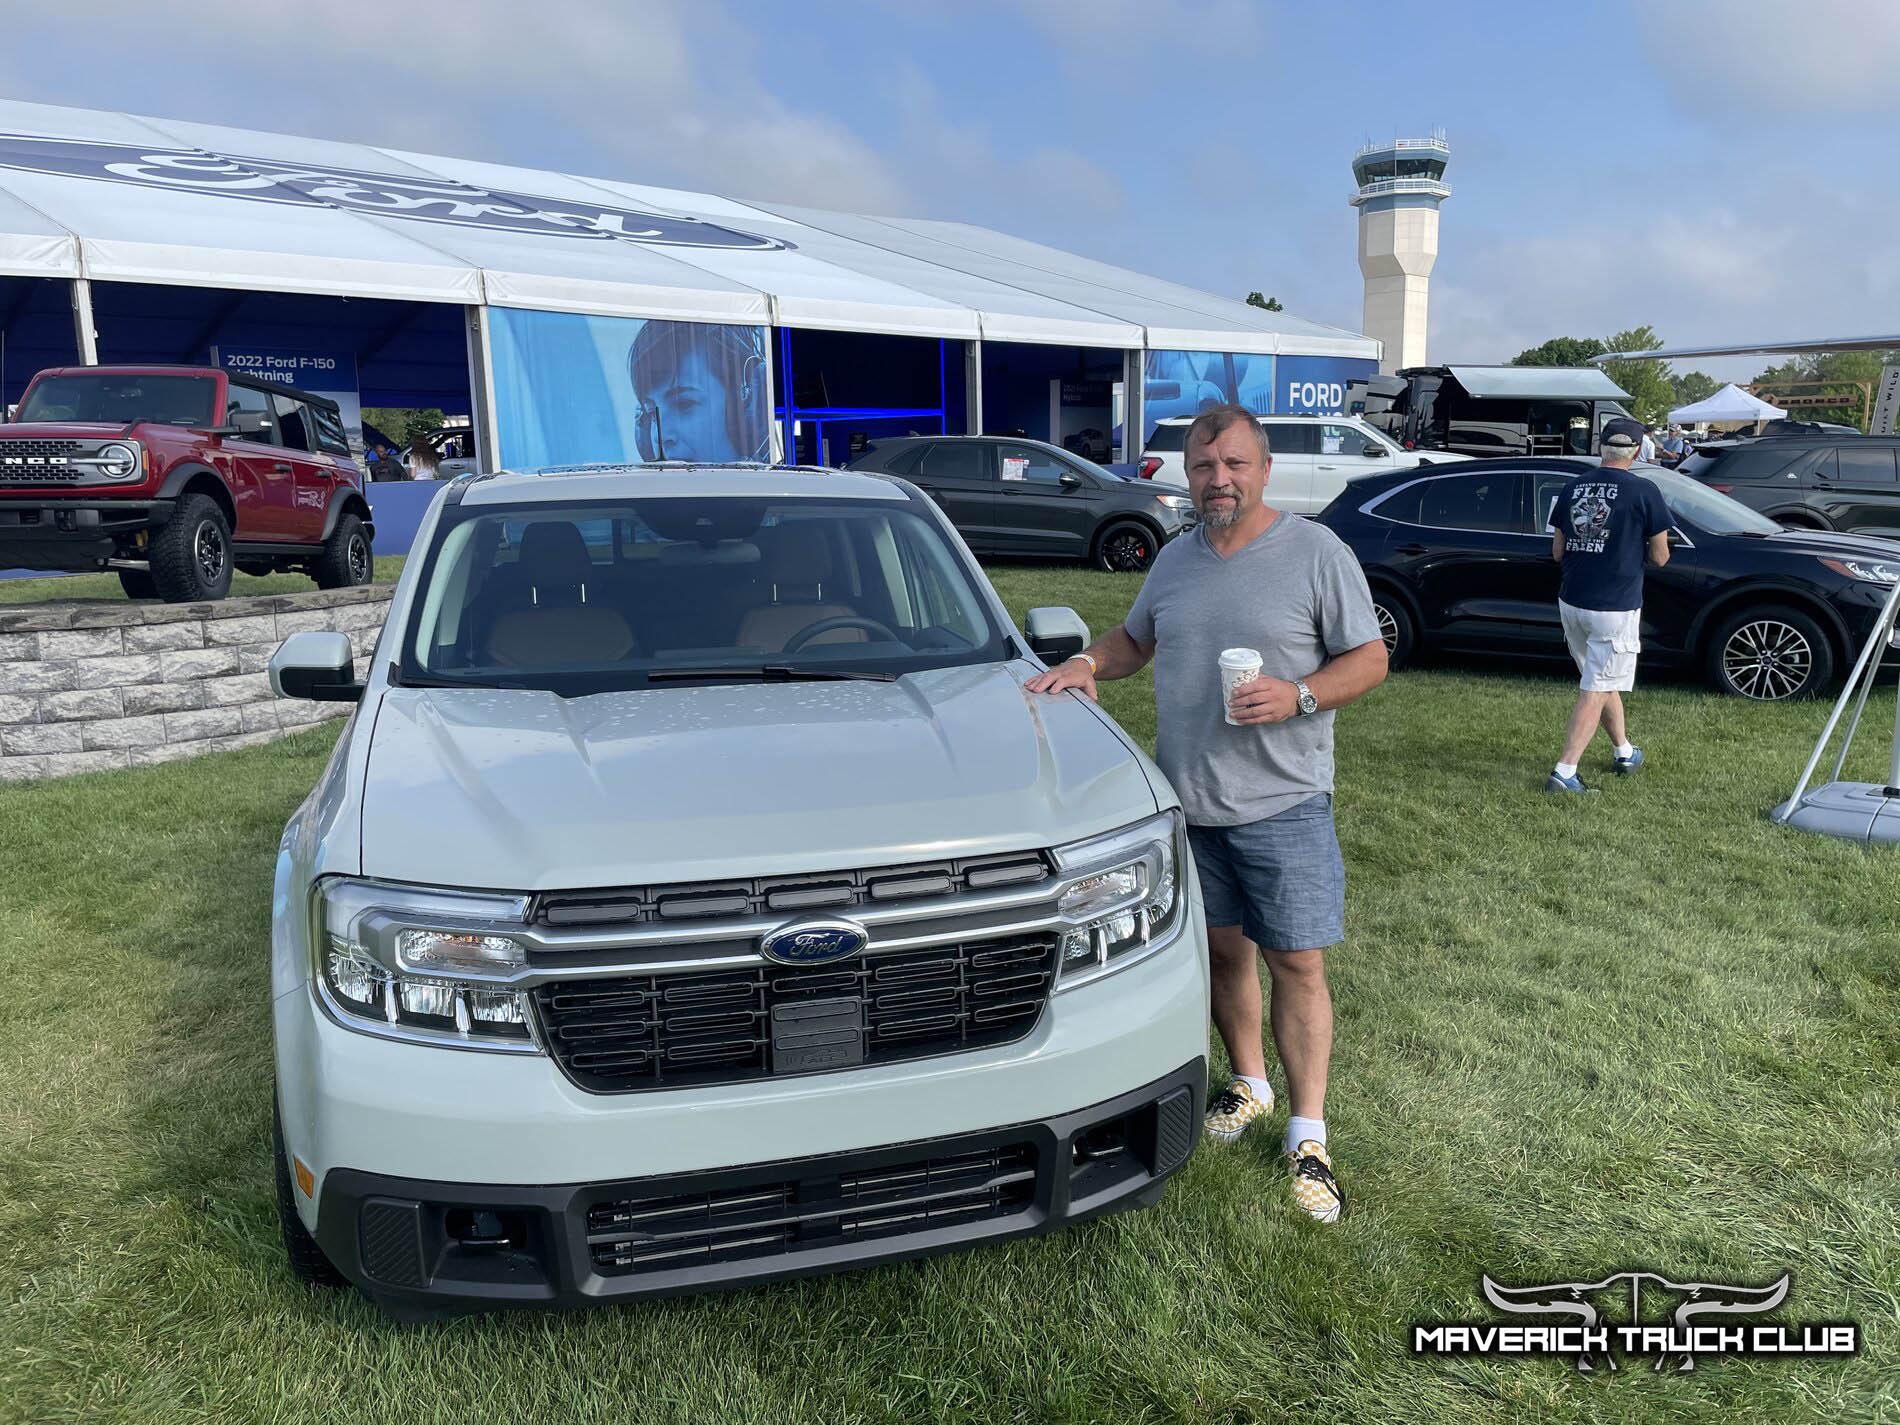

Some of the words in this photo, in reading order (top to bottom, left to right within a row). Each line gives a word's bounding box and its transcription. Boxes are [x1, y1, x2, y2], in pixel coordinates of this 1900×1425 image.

[104, 155, 661, 235] Ford
[227, 355, 263, 367] 2022
[266, 356, 297, 368] Ford
[300, 358, 336, 369] F-150
[236, 369, 294, 384] htning
[1886, 372, 1899, 401] WILD
[1289, 382, 1343, 408] FORD
[1571, 487, 1618, 499] FLAG
[789, 932, 843, 956] Ford
